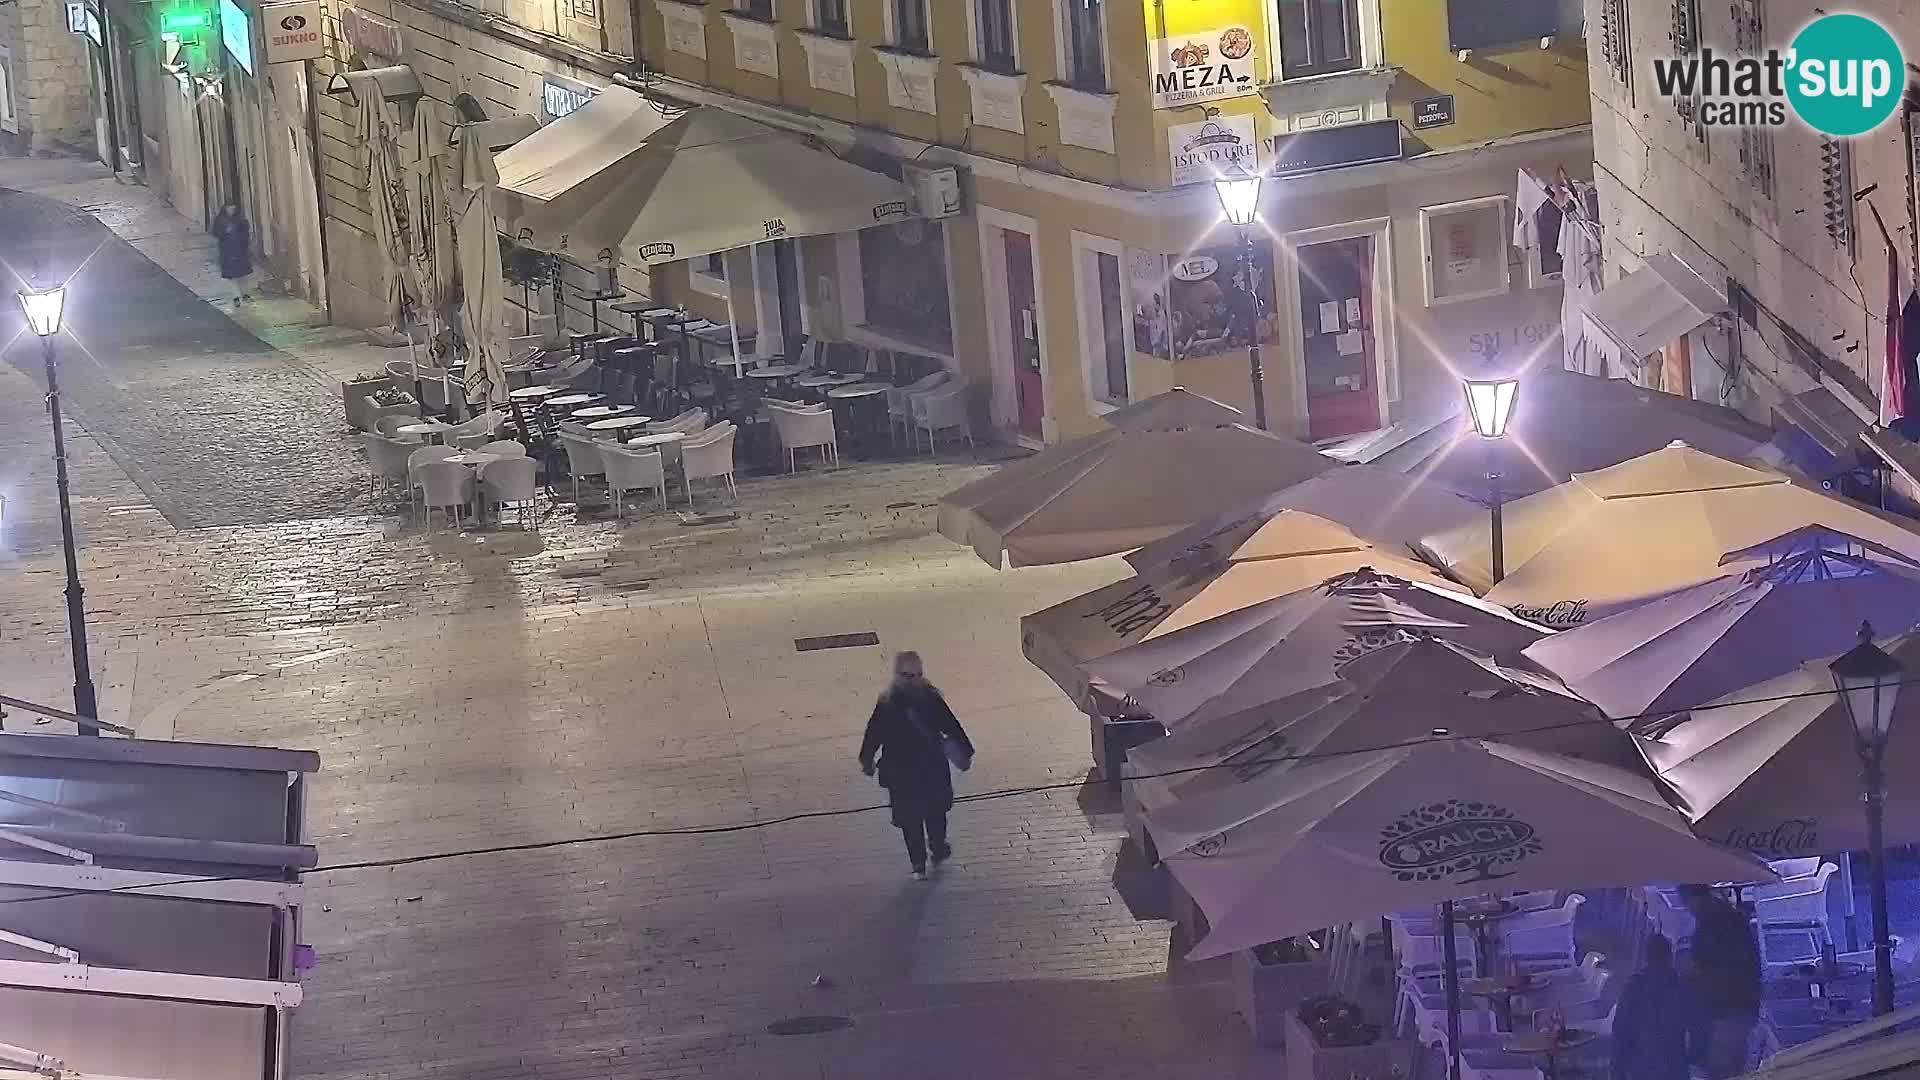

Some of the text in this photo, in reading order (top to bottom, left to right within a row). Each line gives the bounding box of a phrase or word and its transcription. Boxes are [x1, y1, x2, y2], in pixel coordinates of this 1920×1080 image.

[272, 32, 317, 46] SUKNO
[1156, 63, 1234, 94] MEZA
[1165, 91, 1198, 102] PIZZERIA
[1206, 86, 1225, 96] GRILL
[1426, 103, 1438, 113] PUT
[1174, 149, 1220, 167] ISPOD
[1421, 824, 1518, 856] RAUCH
